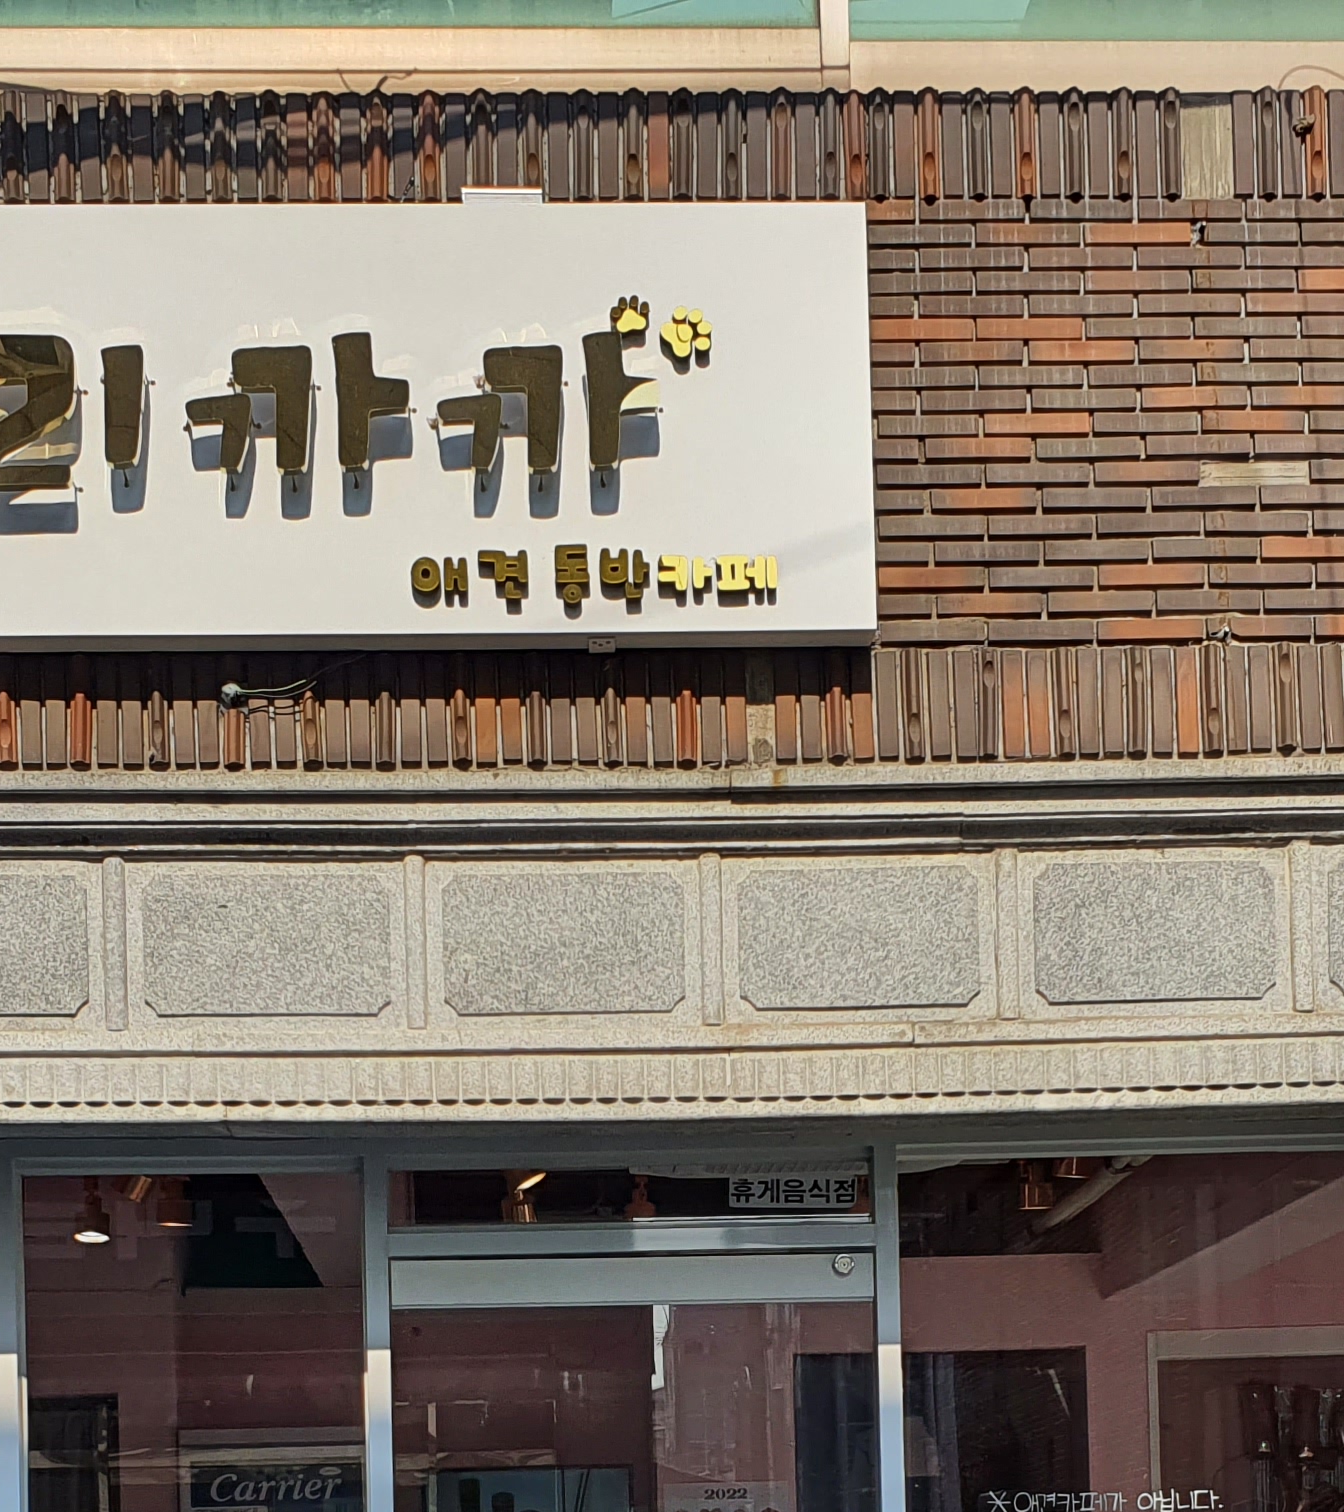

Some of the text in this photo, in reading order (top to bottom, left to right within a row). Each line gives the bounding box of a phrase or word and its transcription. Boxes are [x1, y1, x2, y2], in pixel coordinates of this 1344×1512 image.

[411, 549, 529, 600] 애견
[730, 1178, 856, 1204] 휴게음식점
[209, 1473, 342, 1502] Carrier
[704, 1488, 748, 1500] 2022
[1136, 1488, 1224, 1512] 아닙니다.
